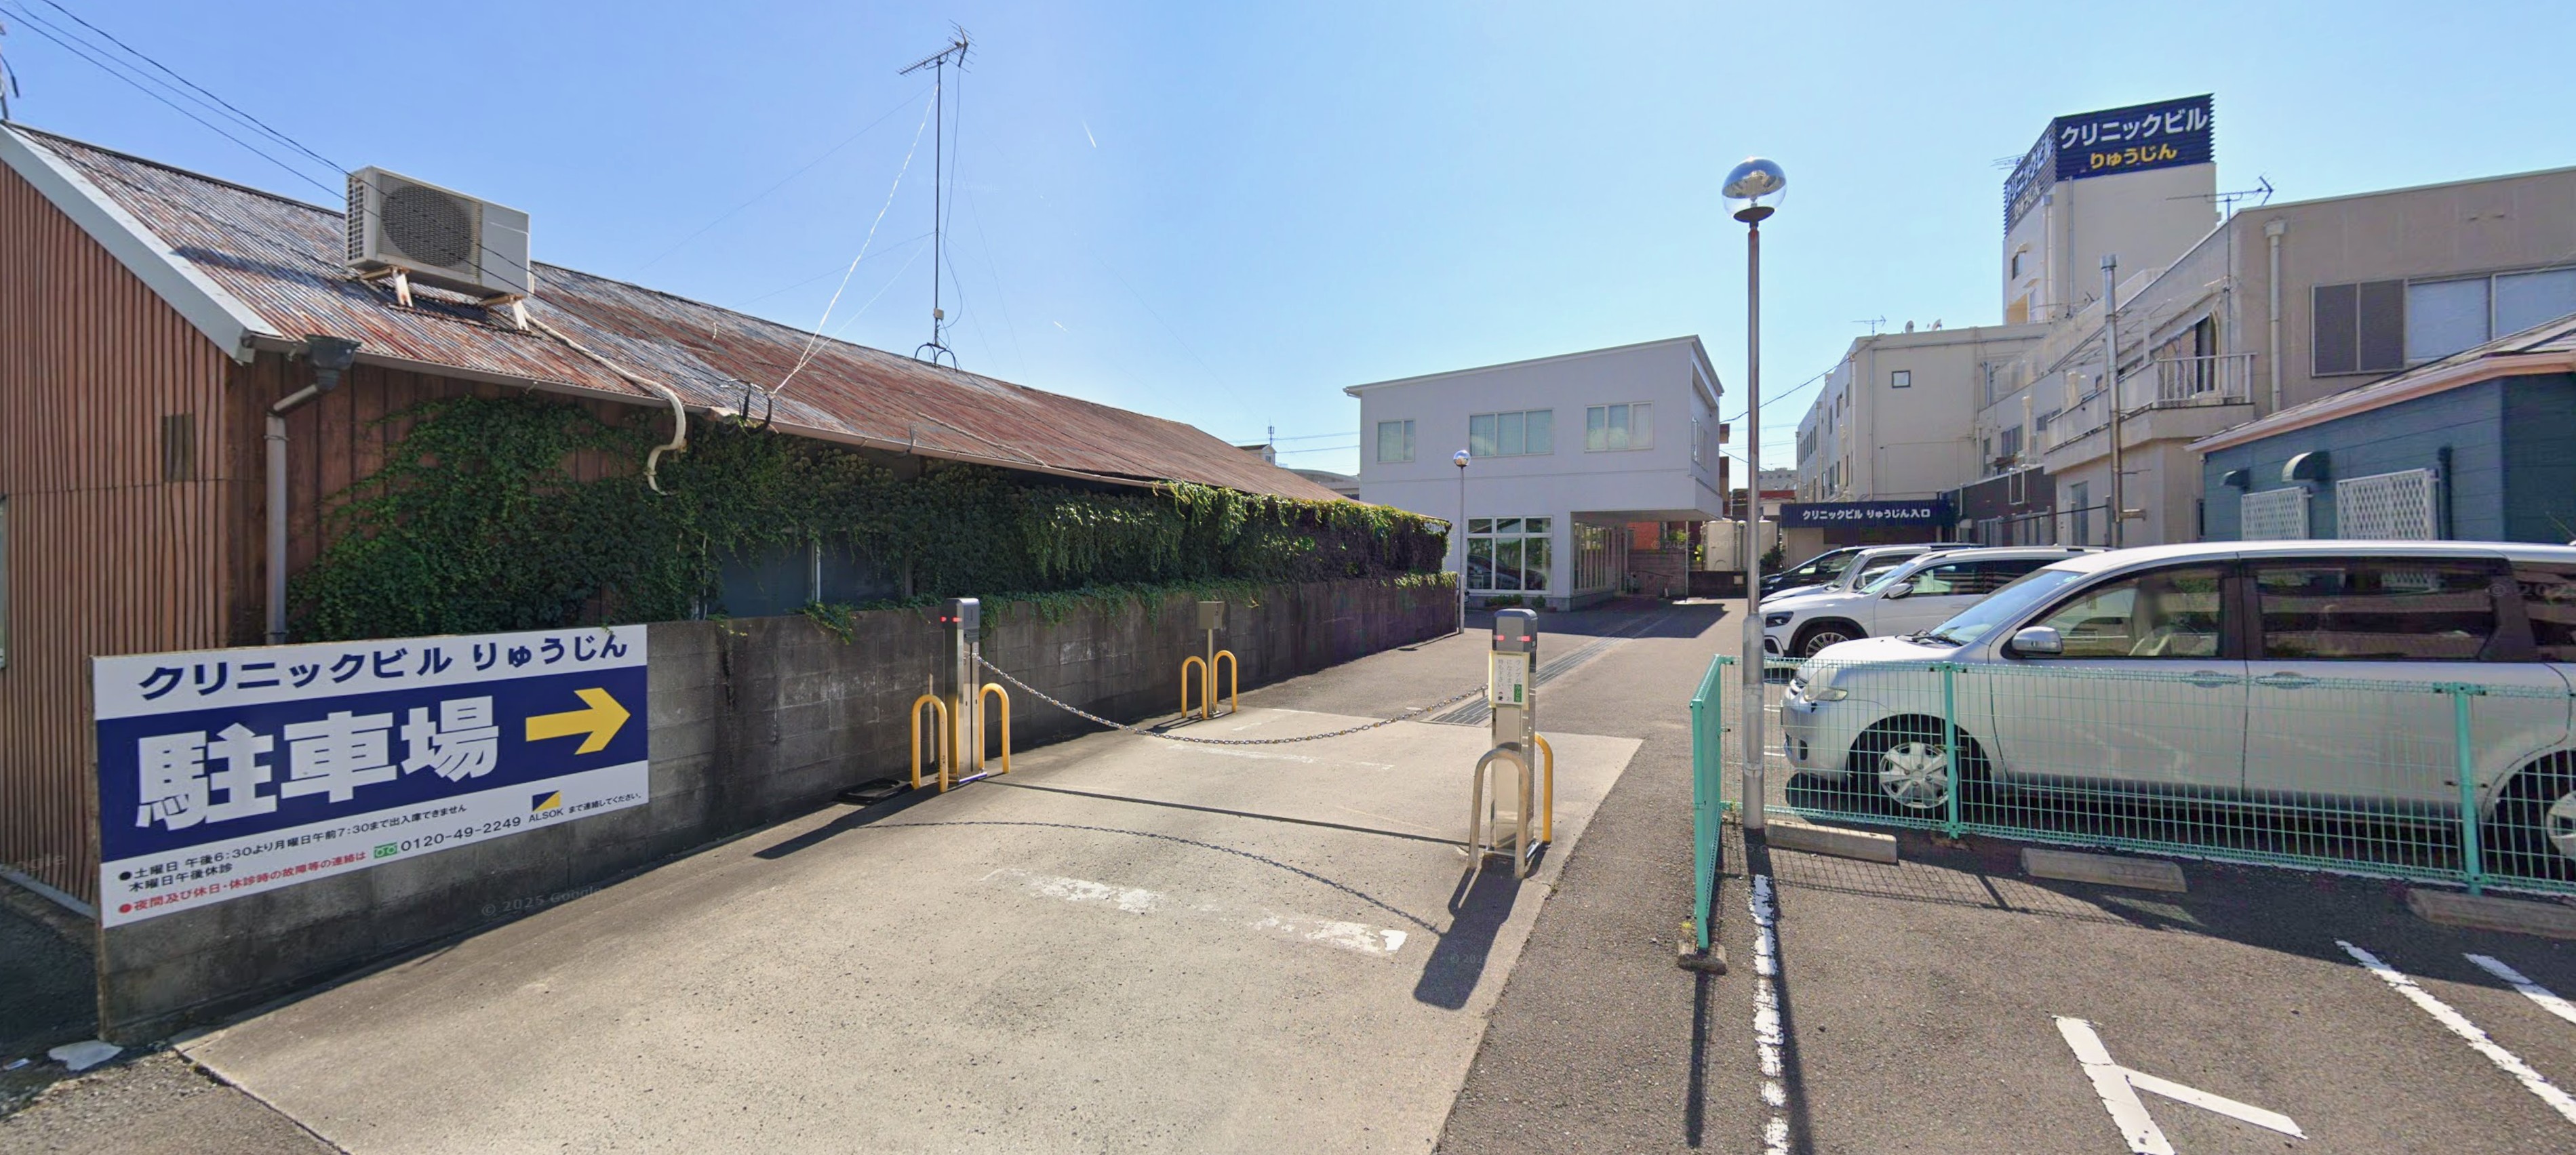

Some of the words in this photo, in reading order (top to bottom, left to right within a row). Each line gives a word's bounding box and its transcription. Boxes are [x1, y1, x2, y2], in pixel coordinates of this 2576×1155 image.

[2060, 107, 2209, 149] クリニックビル
[2090, 143, 2177, 169] りゅうじん
[1802, 509, 1863, 521] クリニックビル
[1867, 508, 1931, 519] りゅうじん入口
[138, 647, 453, 701] クリニックビル
[473, 634, 628, 672] りゅうじん
[136, 695, 500, 832] 駐車場
[401, 817, 521, 851] 0120-49-2249
[528, 808, 563, 823] ALSOK
[129, 863, 233, 892] 木曜日午後休診
[134, 862, 178, 879] 土曜日
